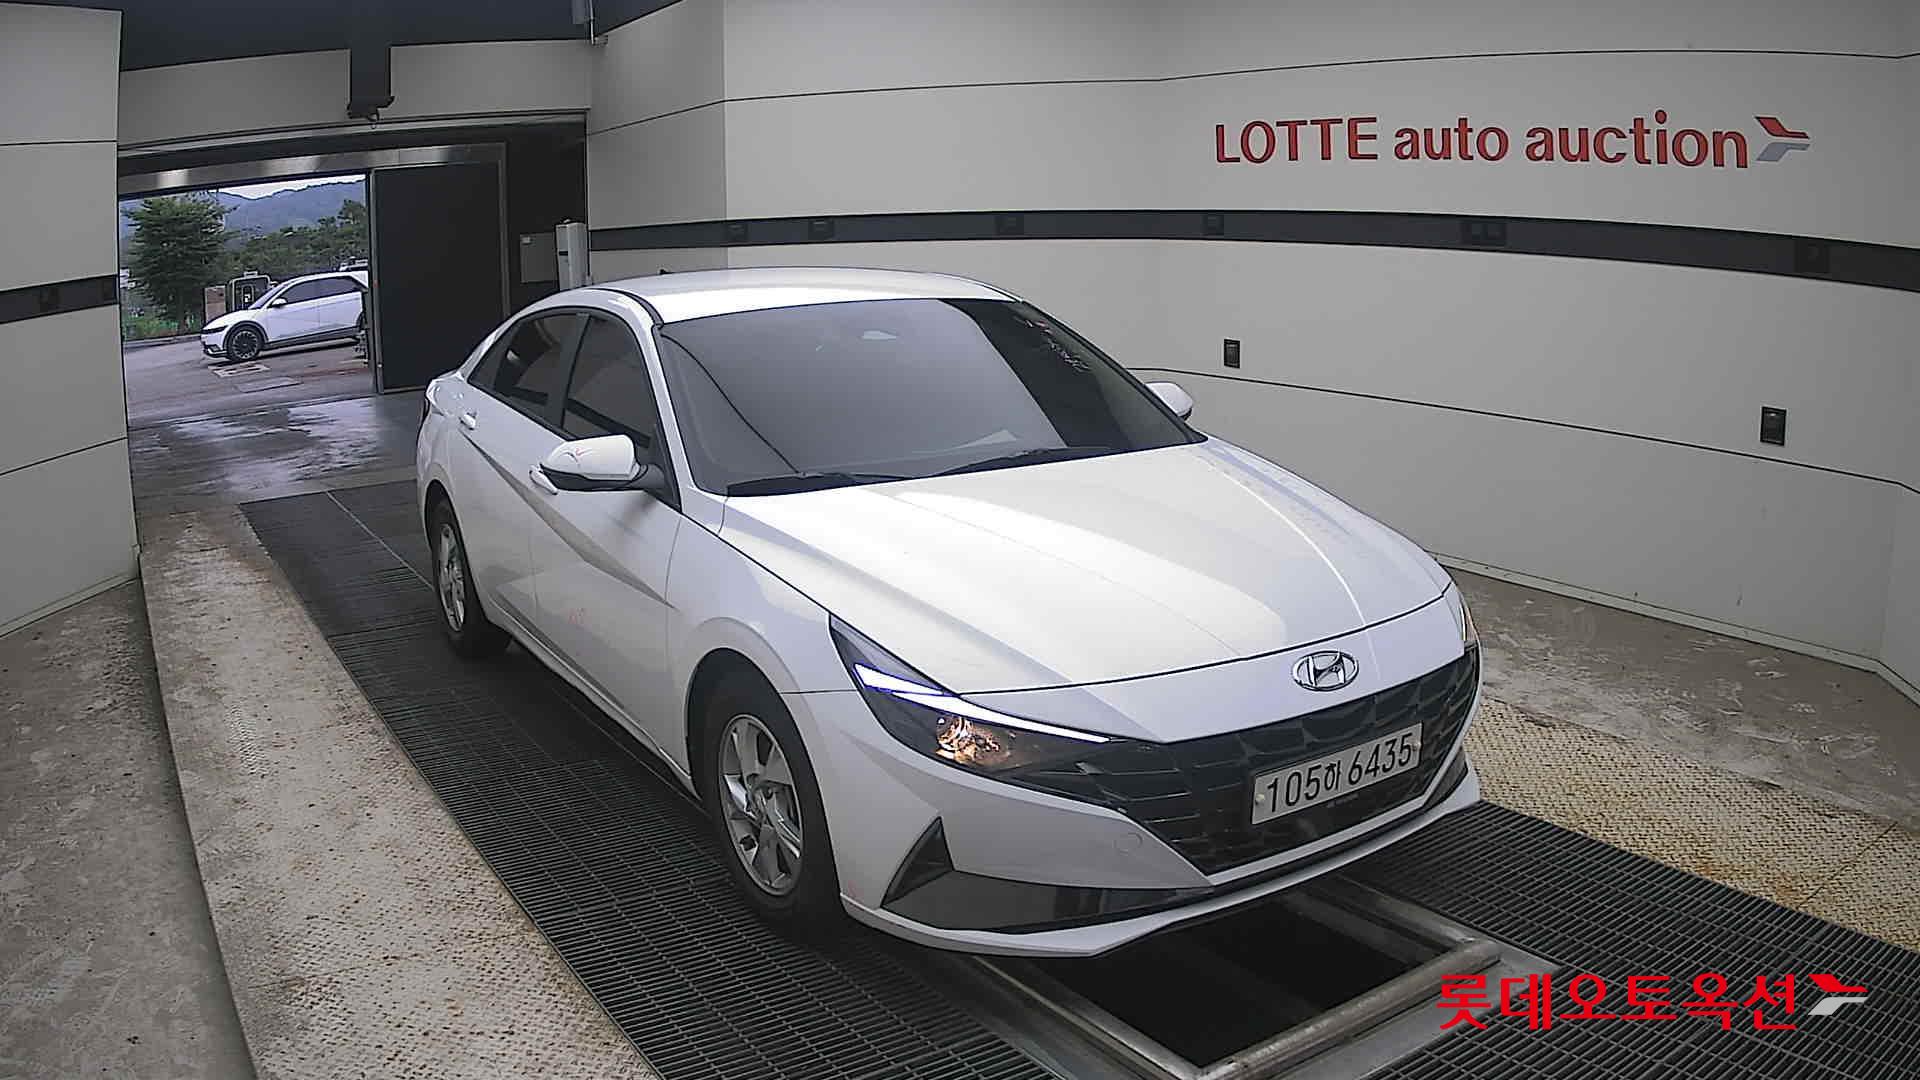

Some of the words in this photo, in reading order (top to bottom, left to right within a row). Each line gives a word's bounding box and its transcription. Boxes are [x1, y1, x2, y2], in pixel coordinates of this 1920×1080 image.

[1215, 117, 1378, 164] LOTTE
[1393, 117, 1509, 161] auto
[1525, 109, 1749, 169] auction
[1267, 760, 1342, 813] 105하
[1348, 732, 1413, 786] 6435
